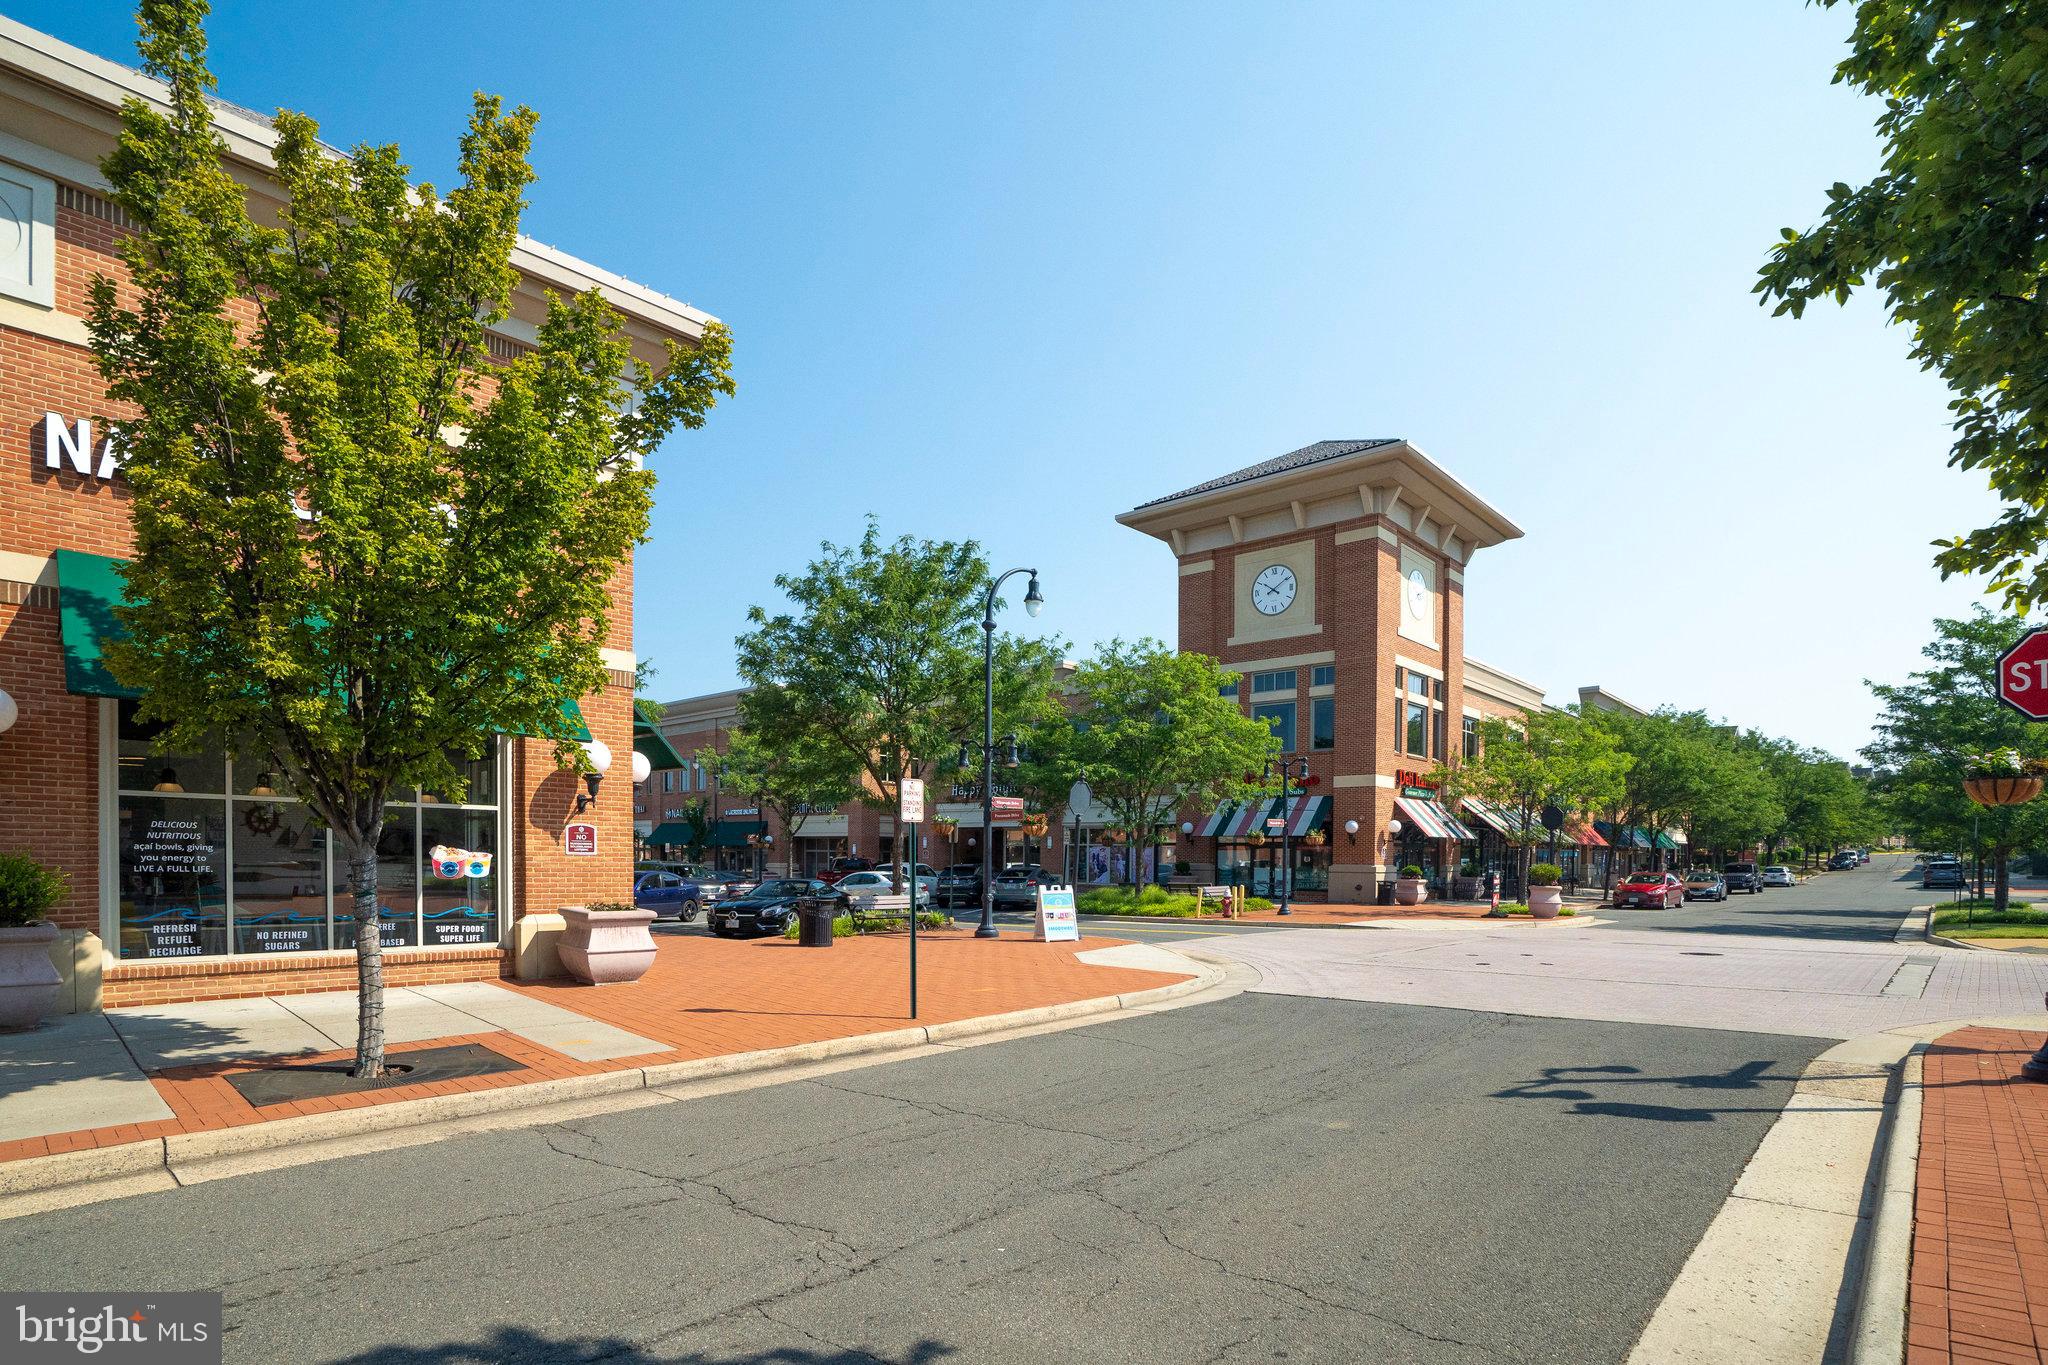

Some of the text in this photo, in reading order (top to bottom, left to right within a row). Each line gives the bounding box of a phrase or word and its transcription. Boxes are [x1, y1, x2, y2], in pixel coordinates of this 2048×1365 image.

[951, 785, 981, 799] Happy
[151, 820, 198, 829] DELICIOUS
[147, 832, 202, 840] NUTRITIOUS
[155, 843, 184, 852] bowls,
[187, 844, 214, 853] giving
[140, 854, 207, 863] you energy to
[134, 865, 214, 873] LIVE A FULL LIFE.
[153, 924, 197, 934] REFRESH
[378, 922, 396, 931] FREE
[435, 925, 485, 933] SUPER FOODS
[256, 930, 308, 940] NO REFINED
[440, 934, 481, 943] SUPER LIFE
[157, 935, 194, 945] REFUEL
[380, 938, 405, 946] BASED
[265, 941, 300, 951] SUGARS
[150, 946, 202, 957] RECHARGE
